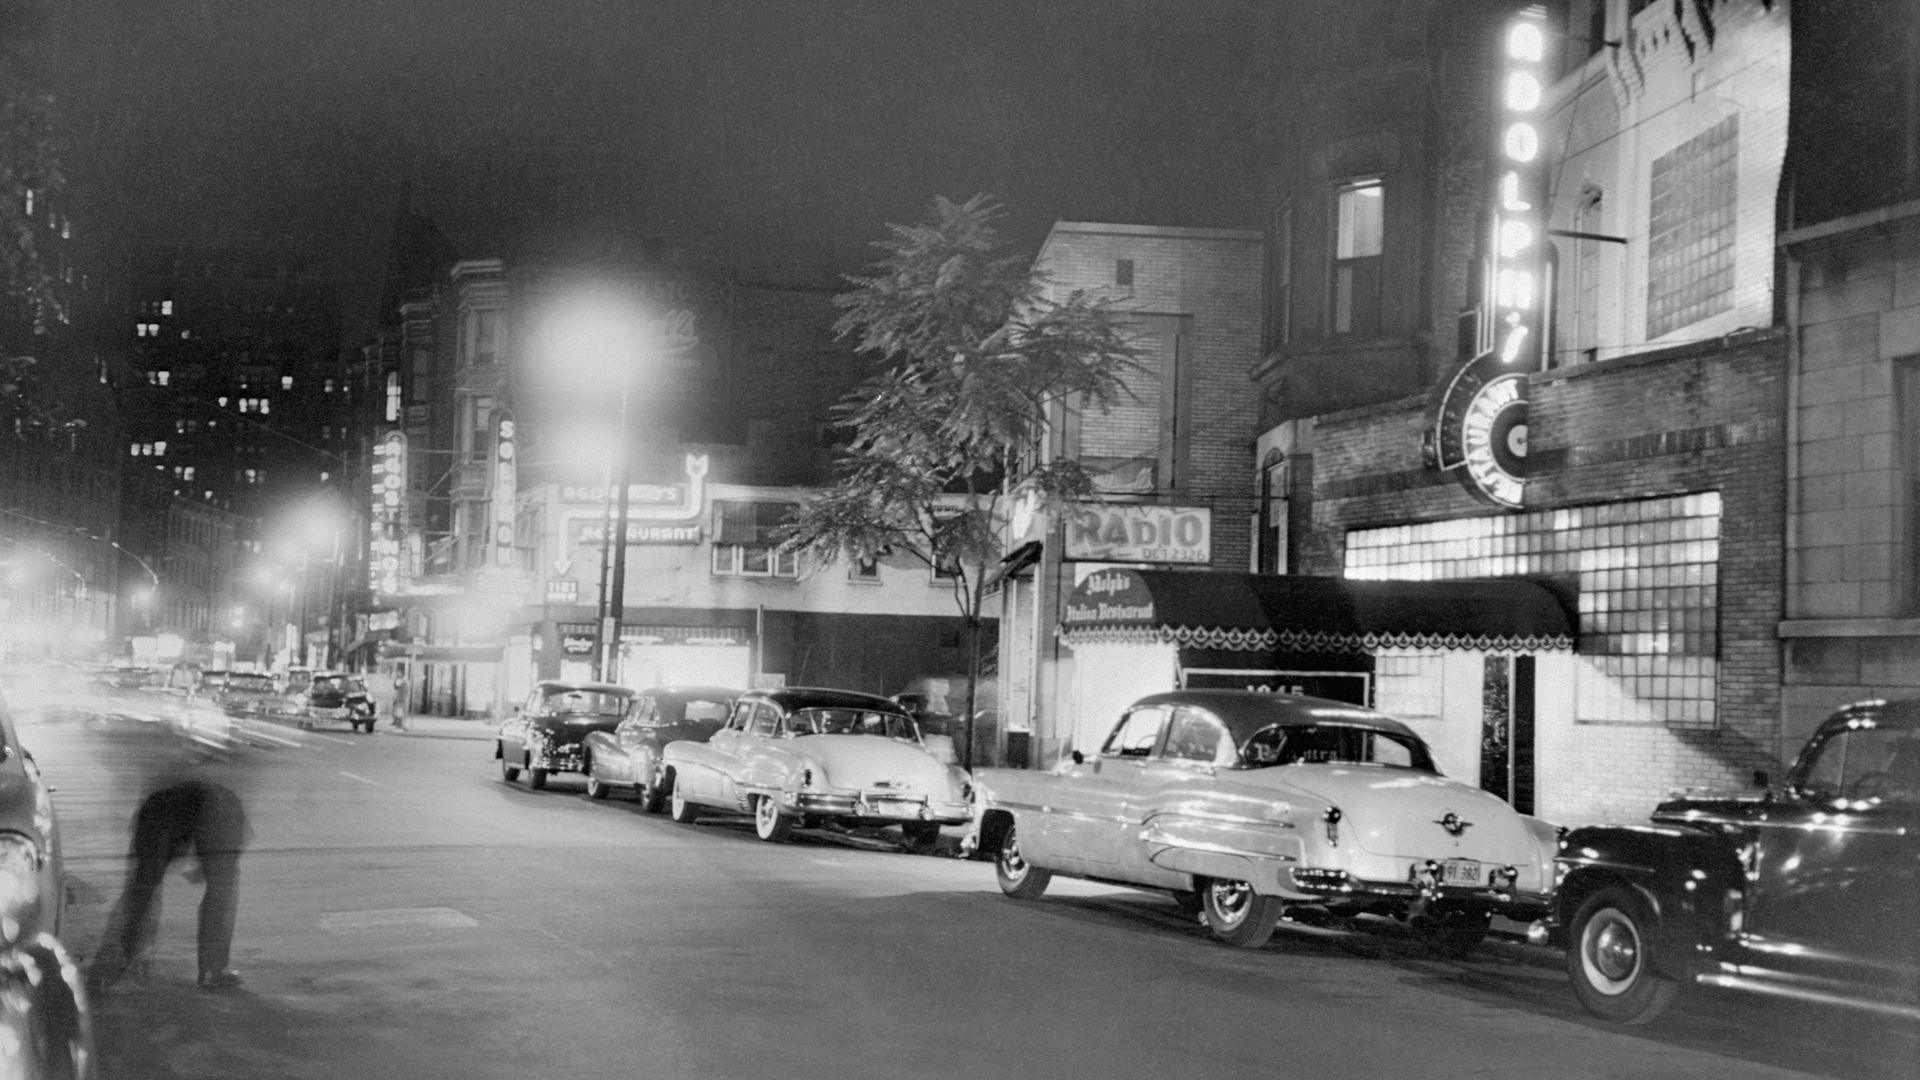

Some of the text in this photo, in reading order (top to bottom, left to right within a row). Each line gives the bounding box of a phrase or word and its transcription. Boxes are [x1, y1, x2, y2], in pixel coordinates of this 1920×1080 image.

[579, 525, 700, 541] RESAURANT
[1074, 511, 1203, 548] RADIO
[1170, 548, 1206, 561] 2326
